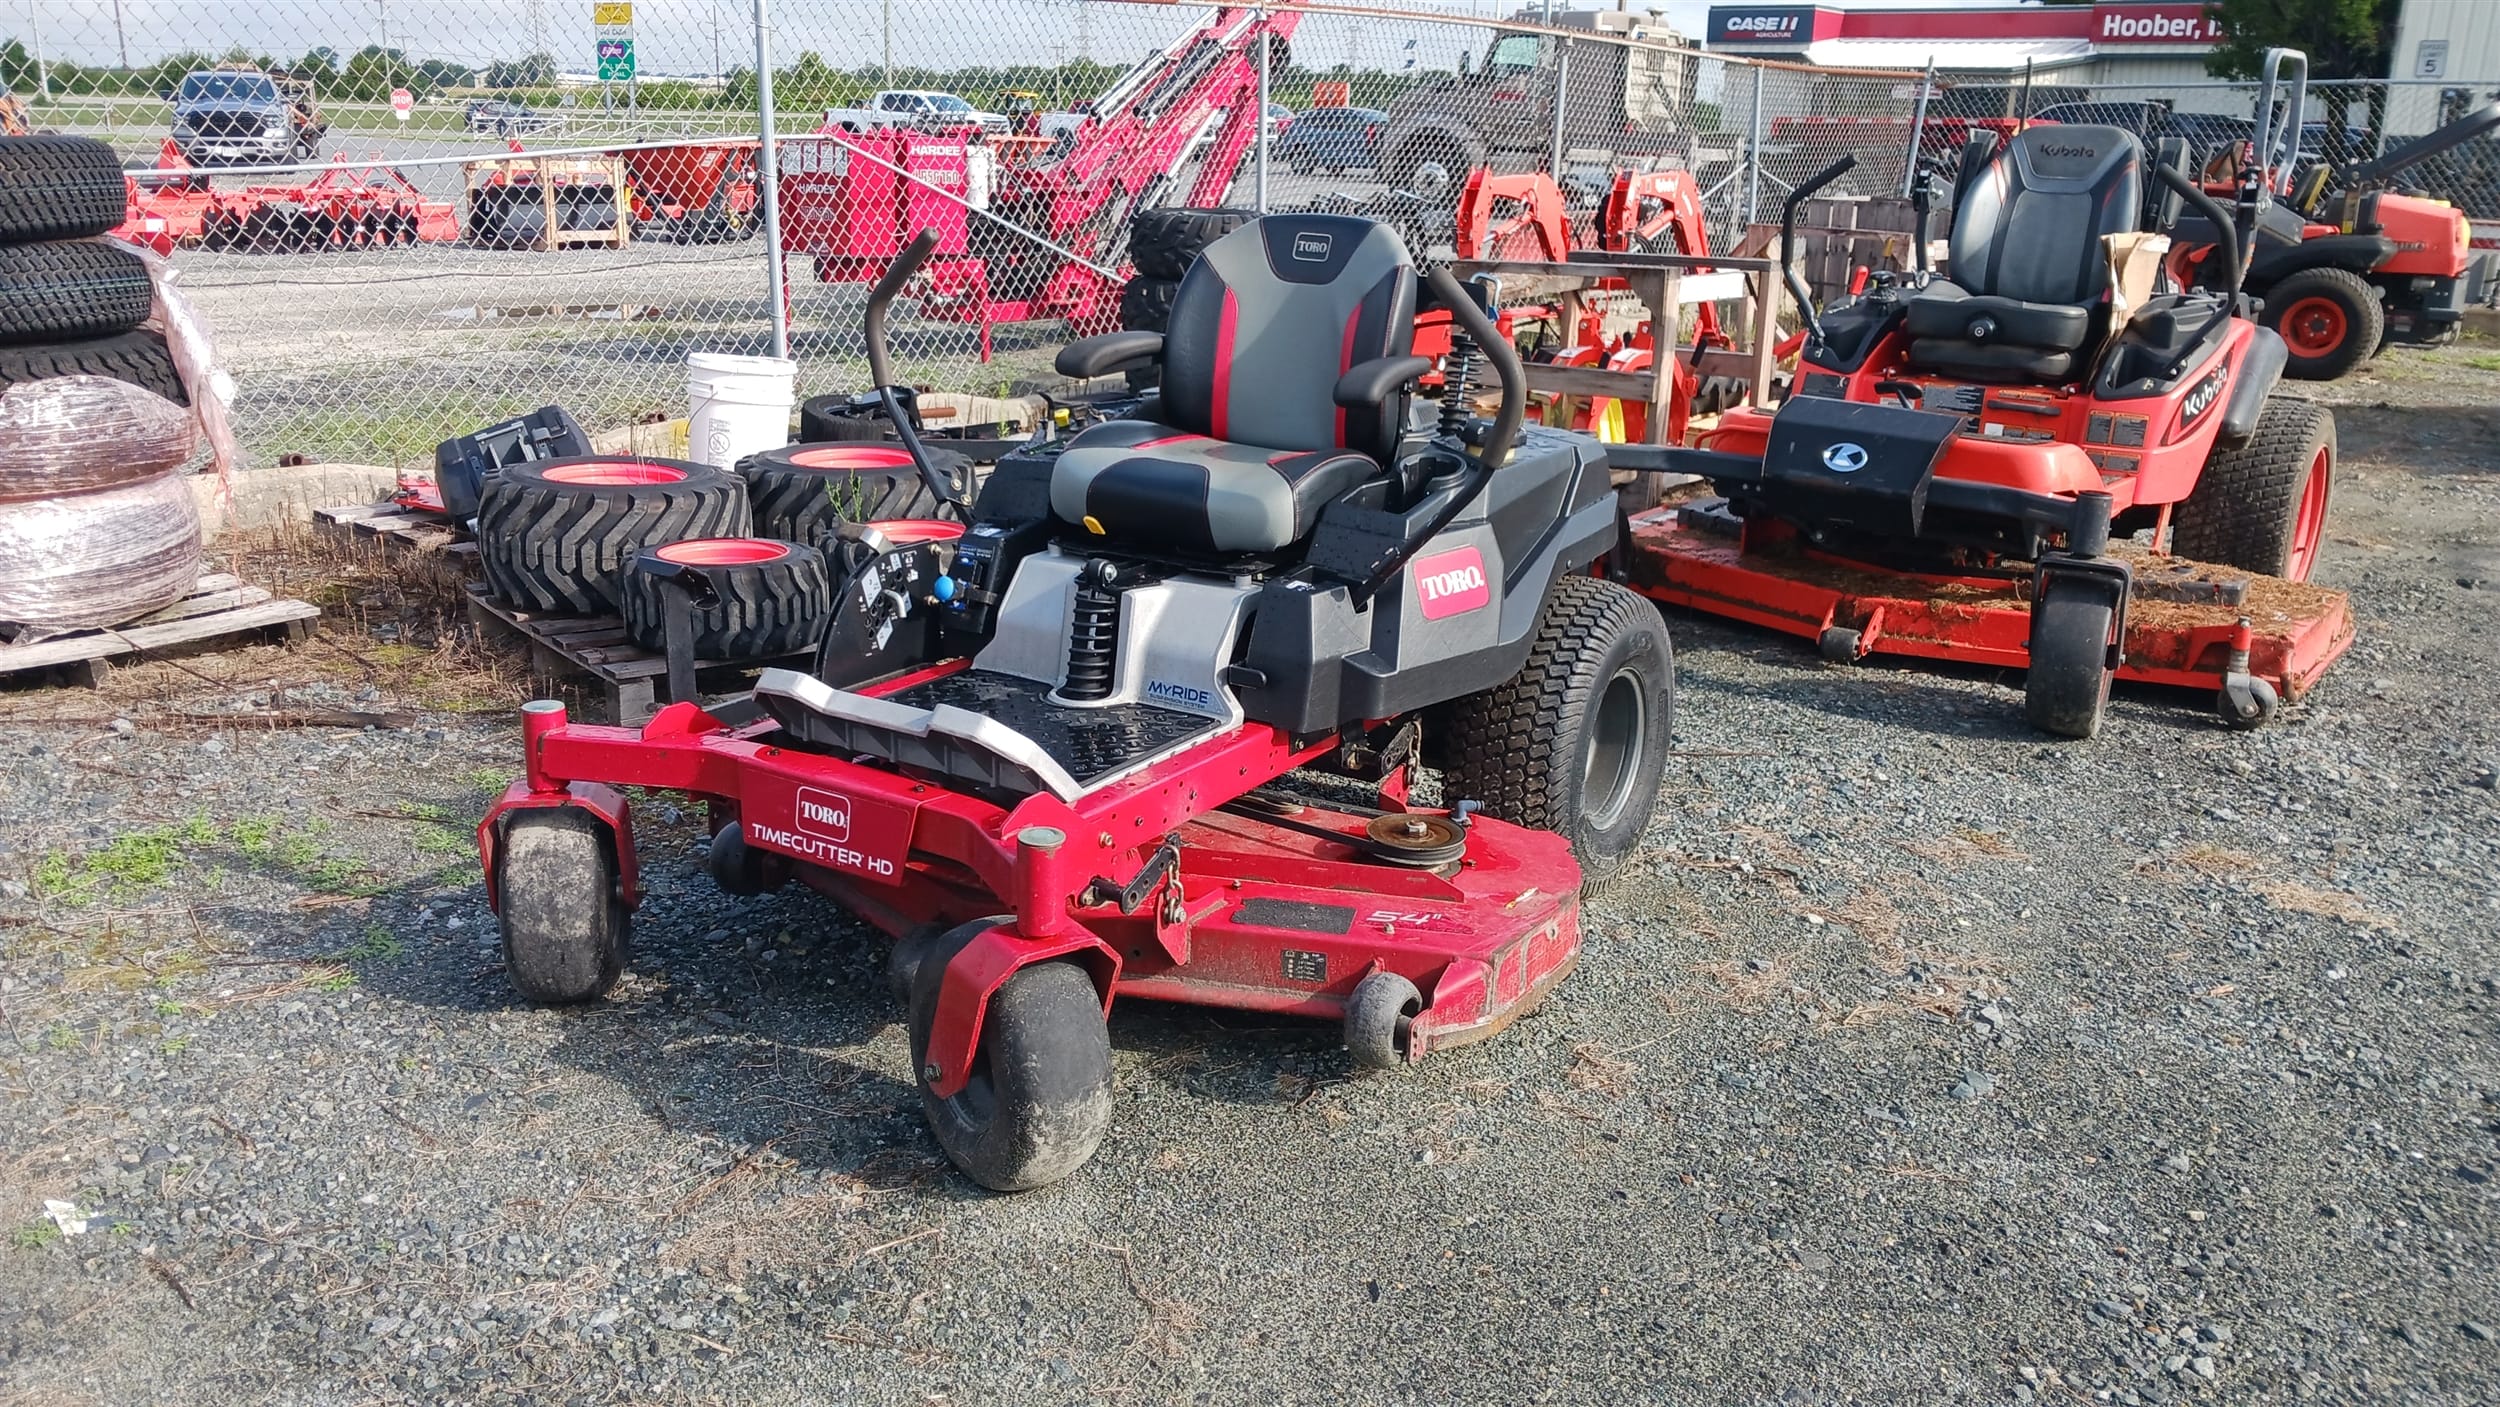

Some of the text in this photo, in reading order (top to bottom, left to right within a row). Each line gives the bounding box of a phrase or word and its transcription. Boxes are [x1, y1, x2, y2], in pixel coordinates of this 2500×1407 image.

[1726, 16, 1780, 31] CASE
[2103, 14, 2201, 40] Hoober,
[2424, 59, 2437, 73] 5
[911, 145, 961, 156] HARDEE
[2040, 143, 2096, 158] Kubota
[1298, 241, 1328, 254] TORO
[2184, 366, 2228, 417] Kubota
[752, 822, 894, 876] TIMECUTTER HD
